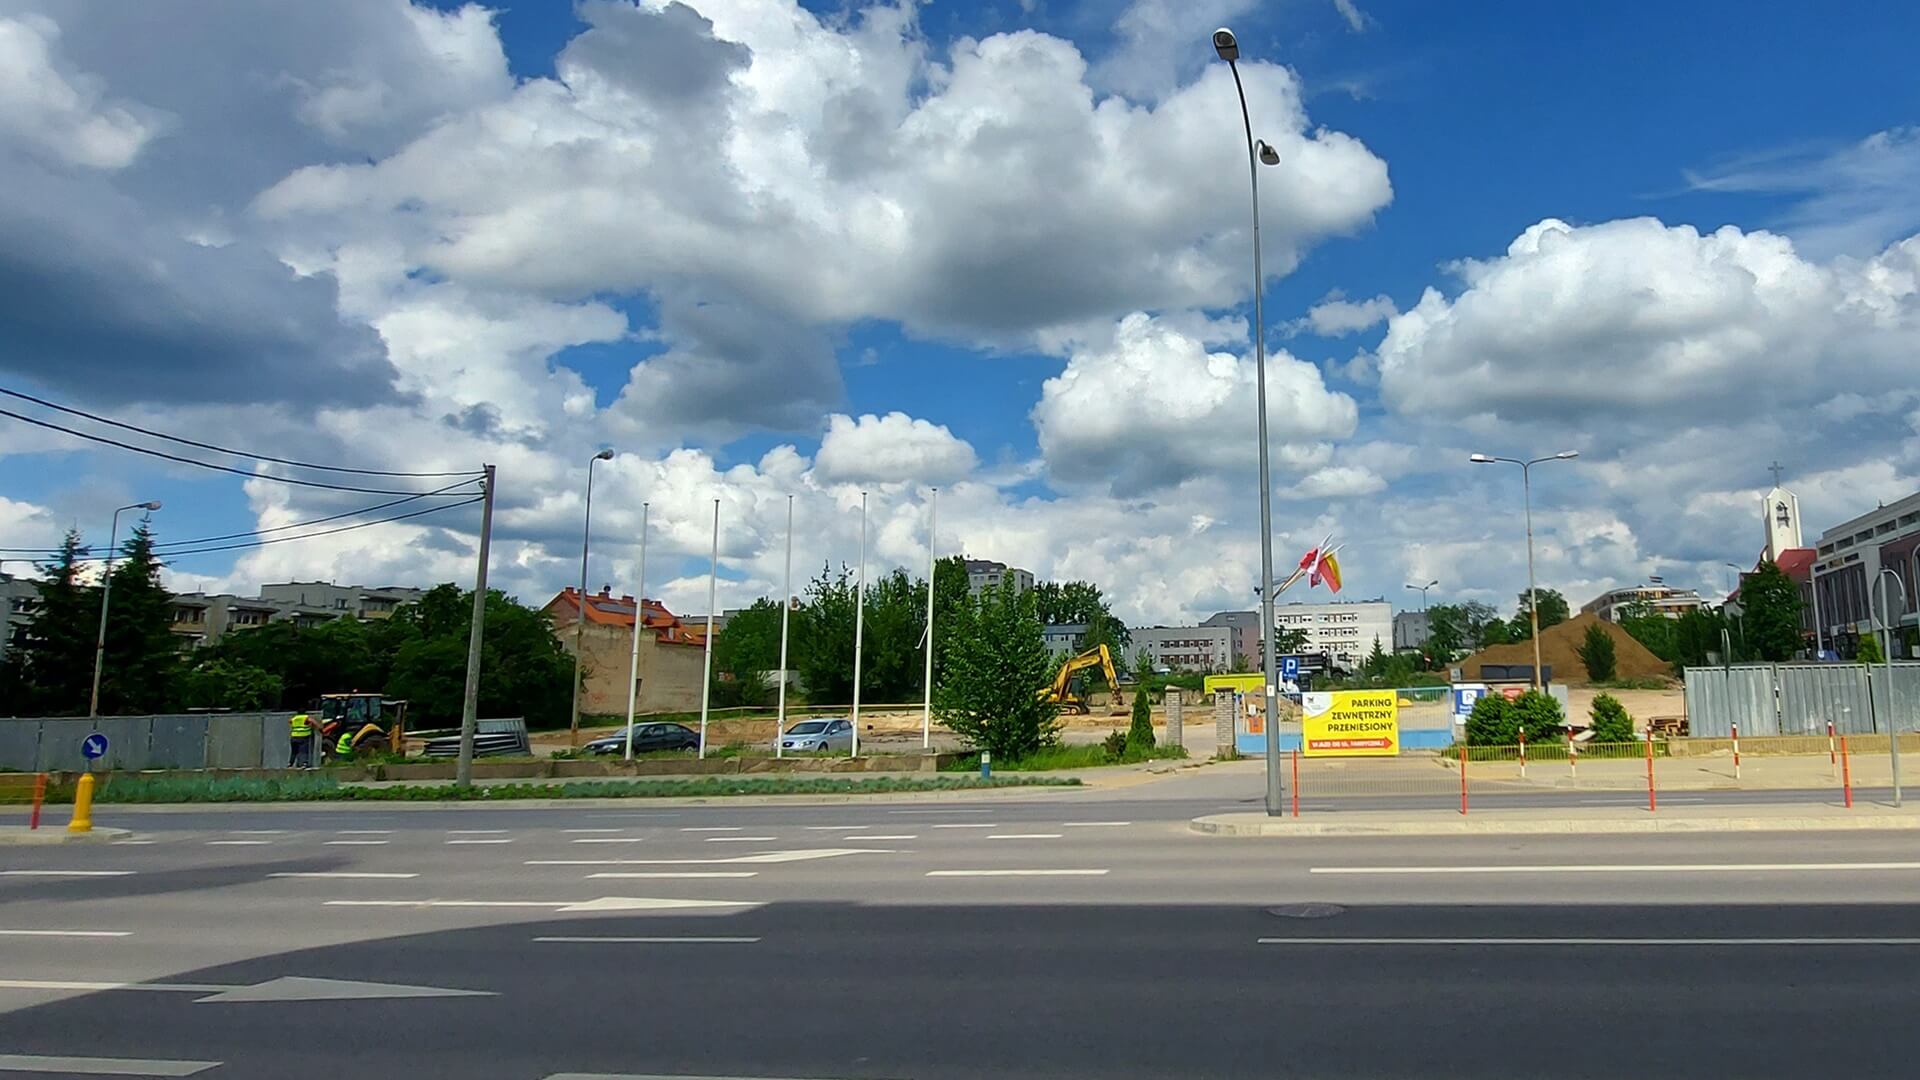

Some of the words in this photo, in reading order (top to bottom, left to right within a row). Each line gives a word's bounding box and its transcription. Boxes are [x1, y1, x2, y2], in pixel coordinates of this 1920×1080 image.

[1286, 659, 1296, 673] P
[1351, 698, 1392, 707] PARKING
[1331, 711, 1392, 720] ZEWNĘTRZNY
[1328, 722, 1393, 732] PRZENIESIONY
